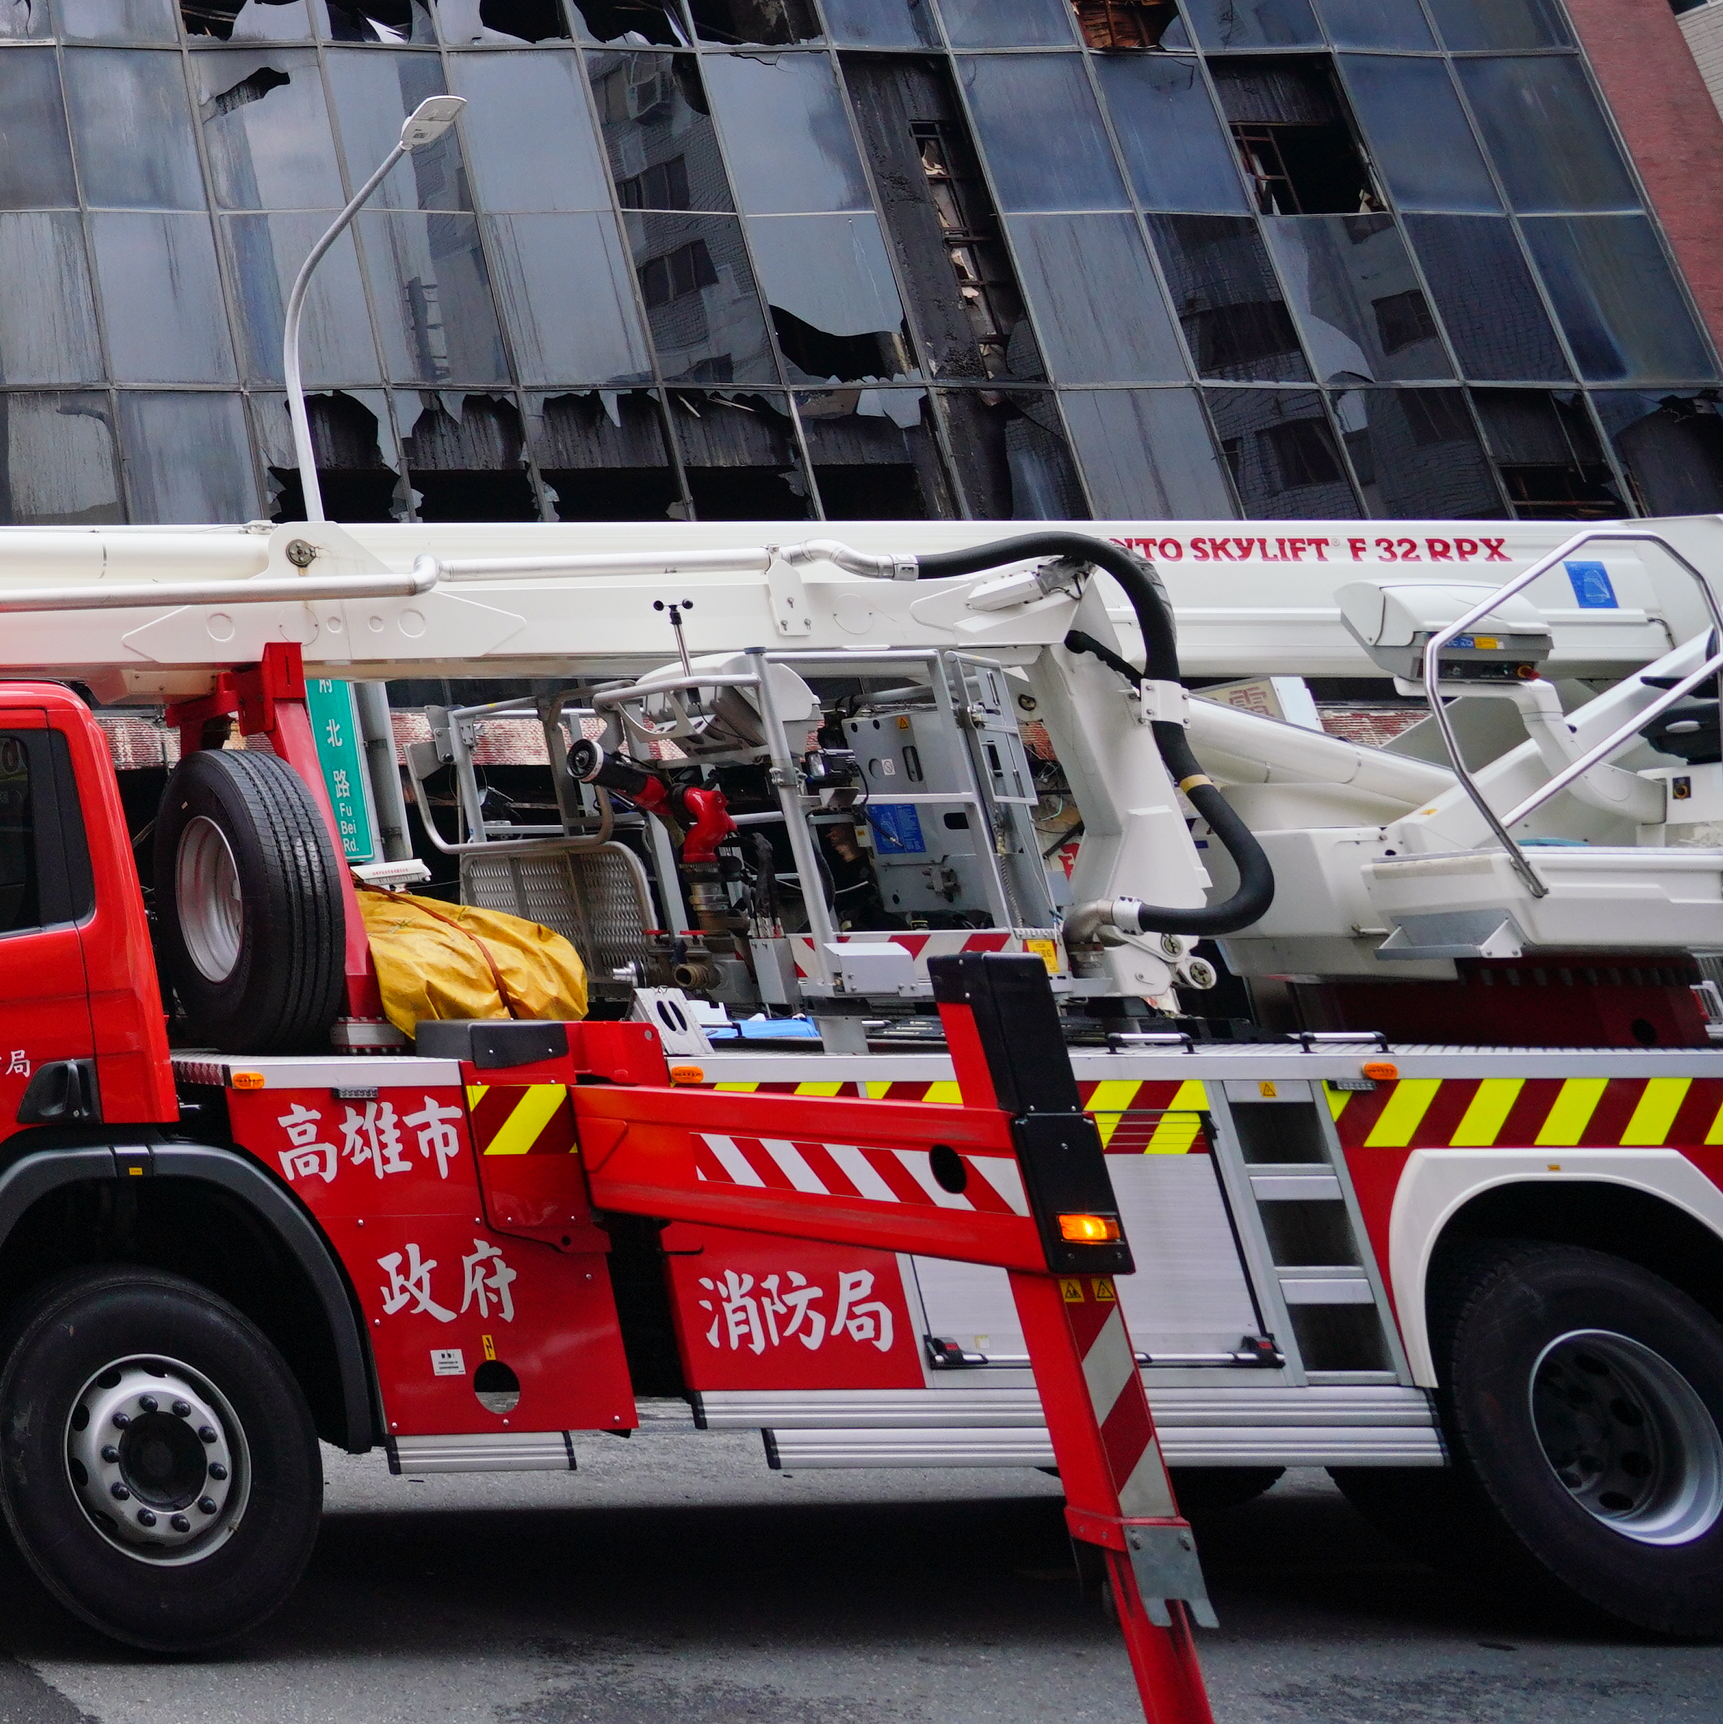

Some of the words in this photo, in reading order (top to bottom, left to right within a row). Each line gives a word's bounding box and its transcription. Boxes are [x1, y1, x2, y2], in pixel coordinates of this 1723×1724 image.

[1347, 538, 1368, 562] F
[1375, 538, 1423, 562] 32
[1425, 538, 1513, 562] RPX
[339, 802, 352, 817] Fu
[341, 821, 357, 835] Bei
[343, 838, 359, 852] Rd.
[277, 1095, 463, 1183] 高雄市
[376, 1238, 517, 1323] 政府
[698, 1269, 894, 1355] 消防局
